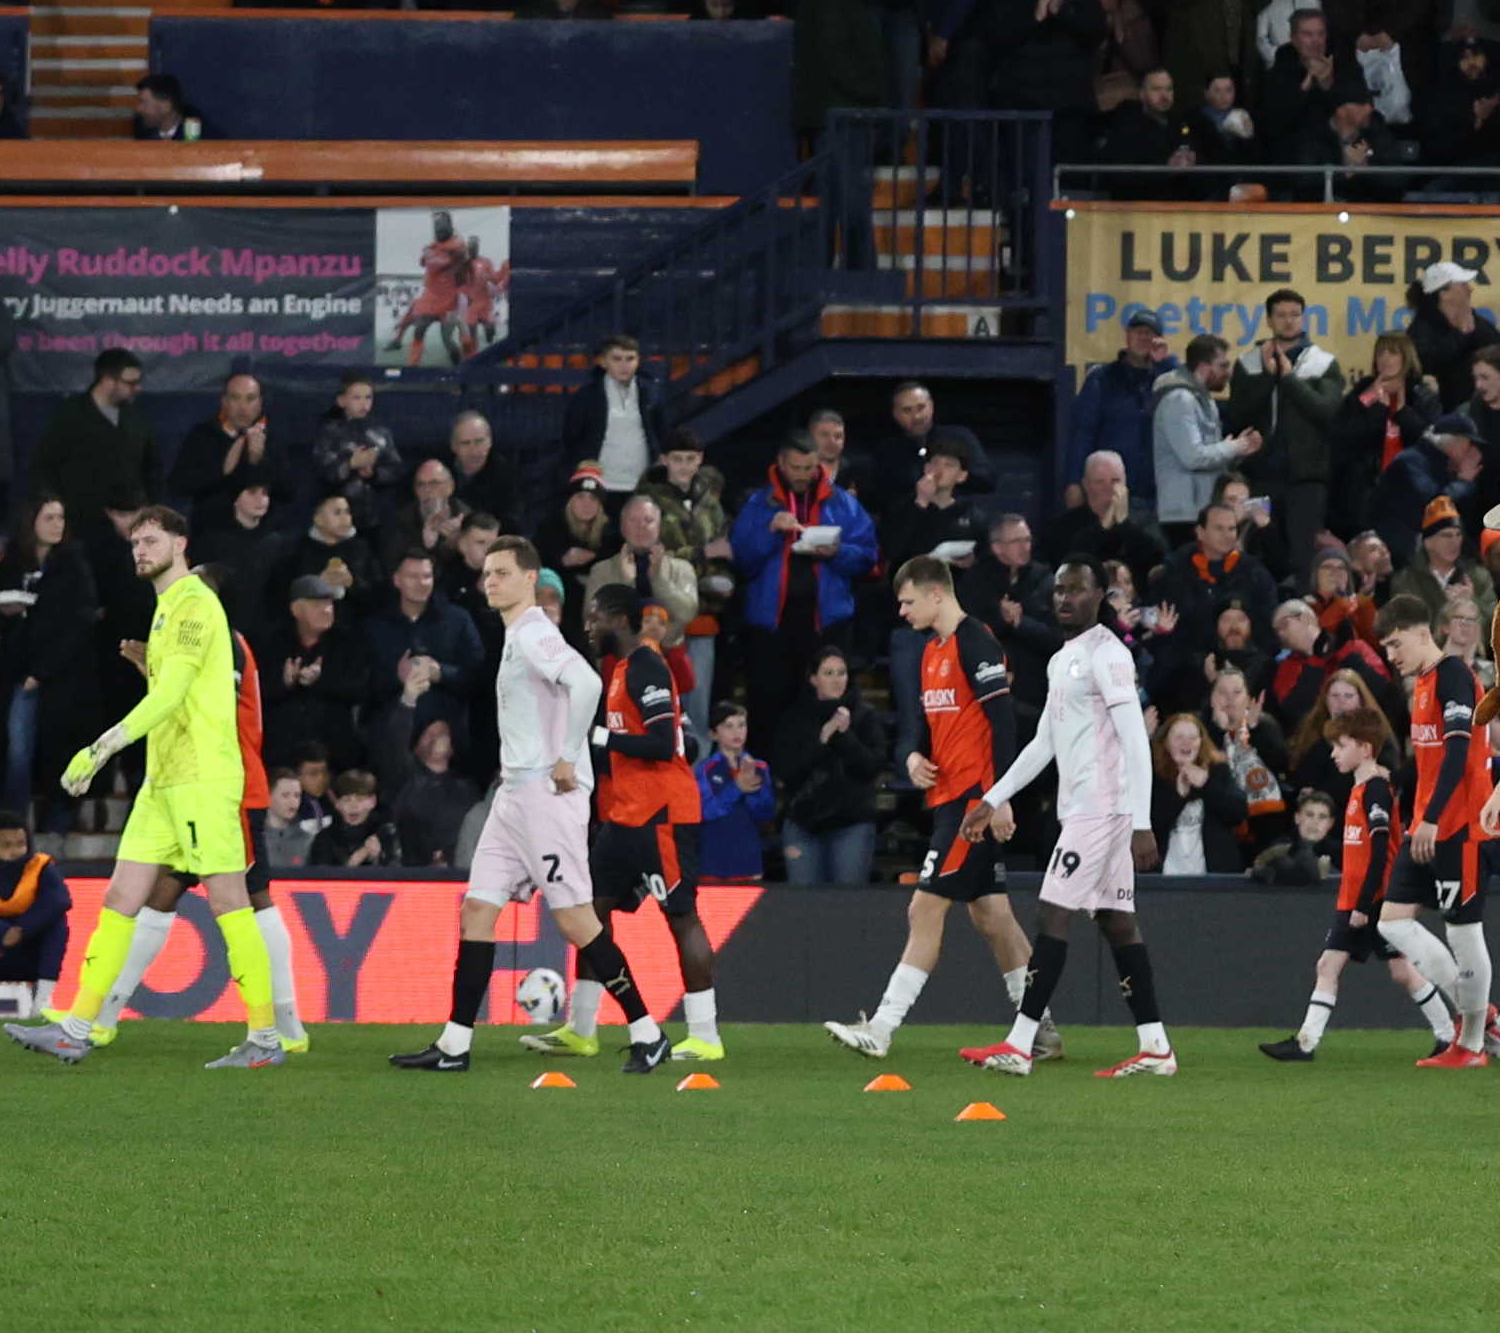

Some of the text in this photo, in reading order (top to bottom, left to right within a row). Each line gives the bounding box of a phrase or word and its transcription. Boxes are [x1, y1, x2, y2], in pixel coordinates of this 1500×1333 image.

[56, 246, 211, 277] Ruddock
[221, 248, 363, 285] Mpanzu
[1121, 231, 1292, 282] LUKE
[31, 294, 164, 319] Juggernaut
[169, 294, 244, 315] Needs
[249, 297, 278, 314] an
[284, 294, 361, 321] Engine
[38, 332, 97, 351] been
[104, 332, 198, 357] through
[203, 331, 220, 351] it
[224, 332, 254, 351] all
[260, 332, 365, 357] together
[187, 821, 198, 848] 1
[542, 854, 563, 882] 2
[1052, 847, 1081, 878] 19
